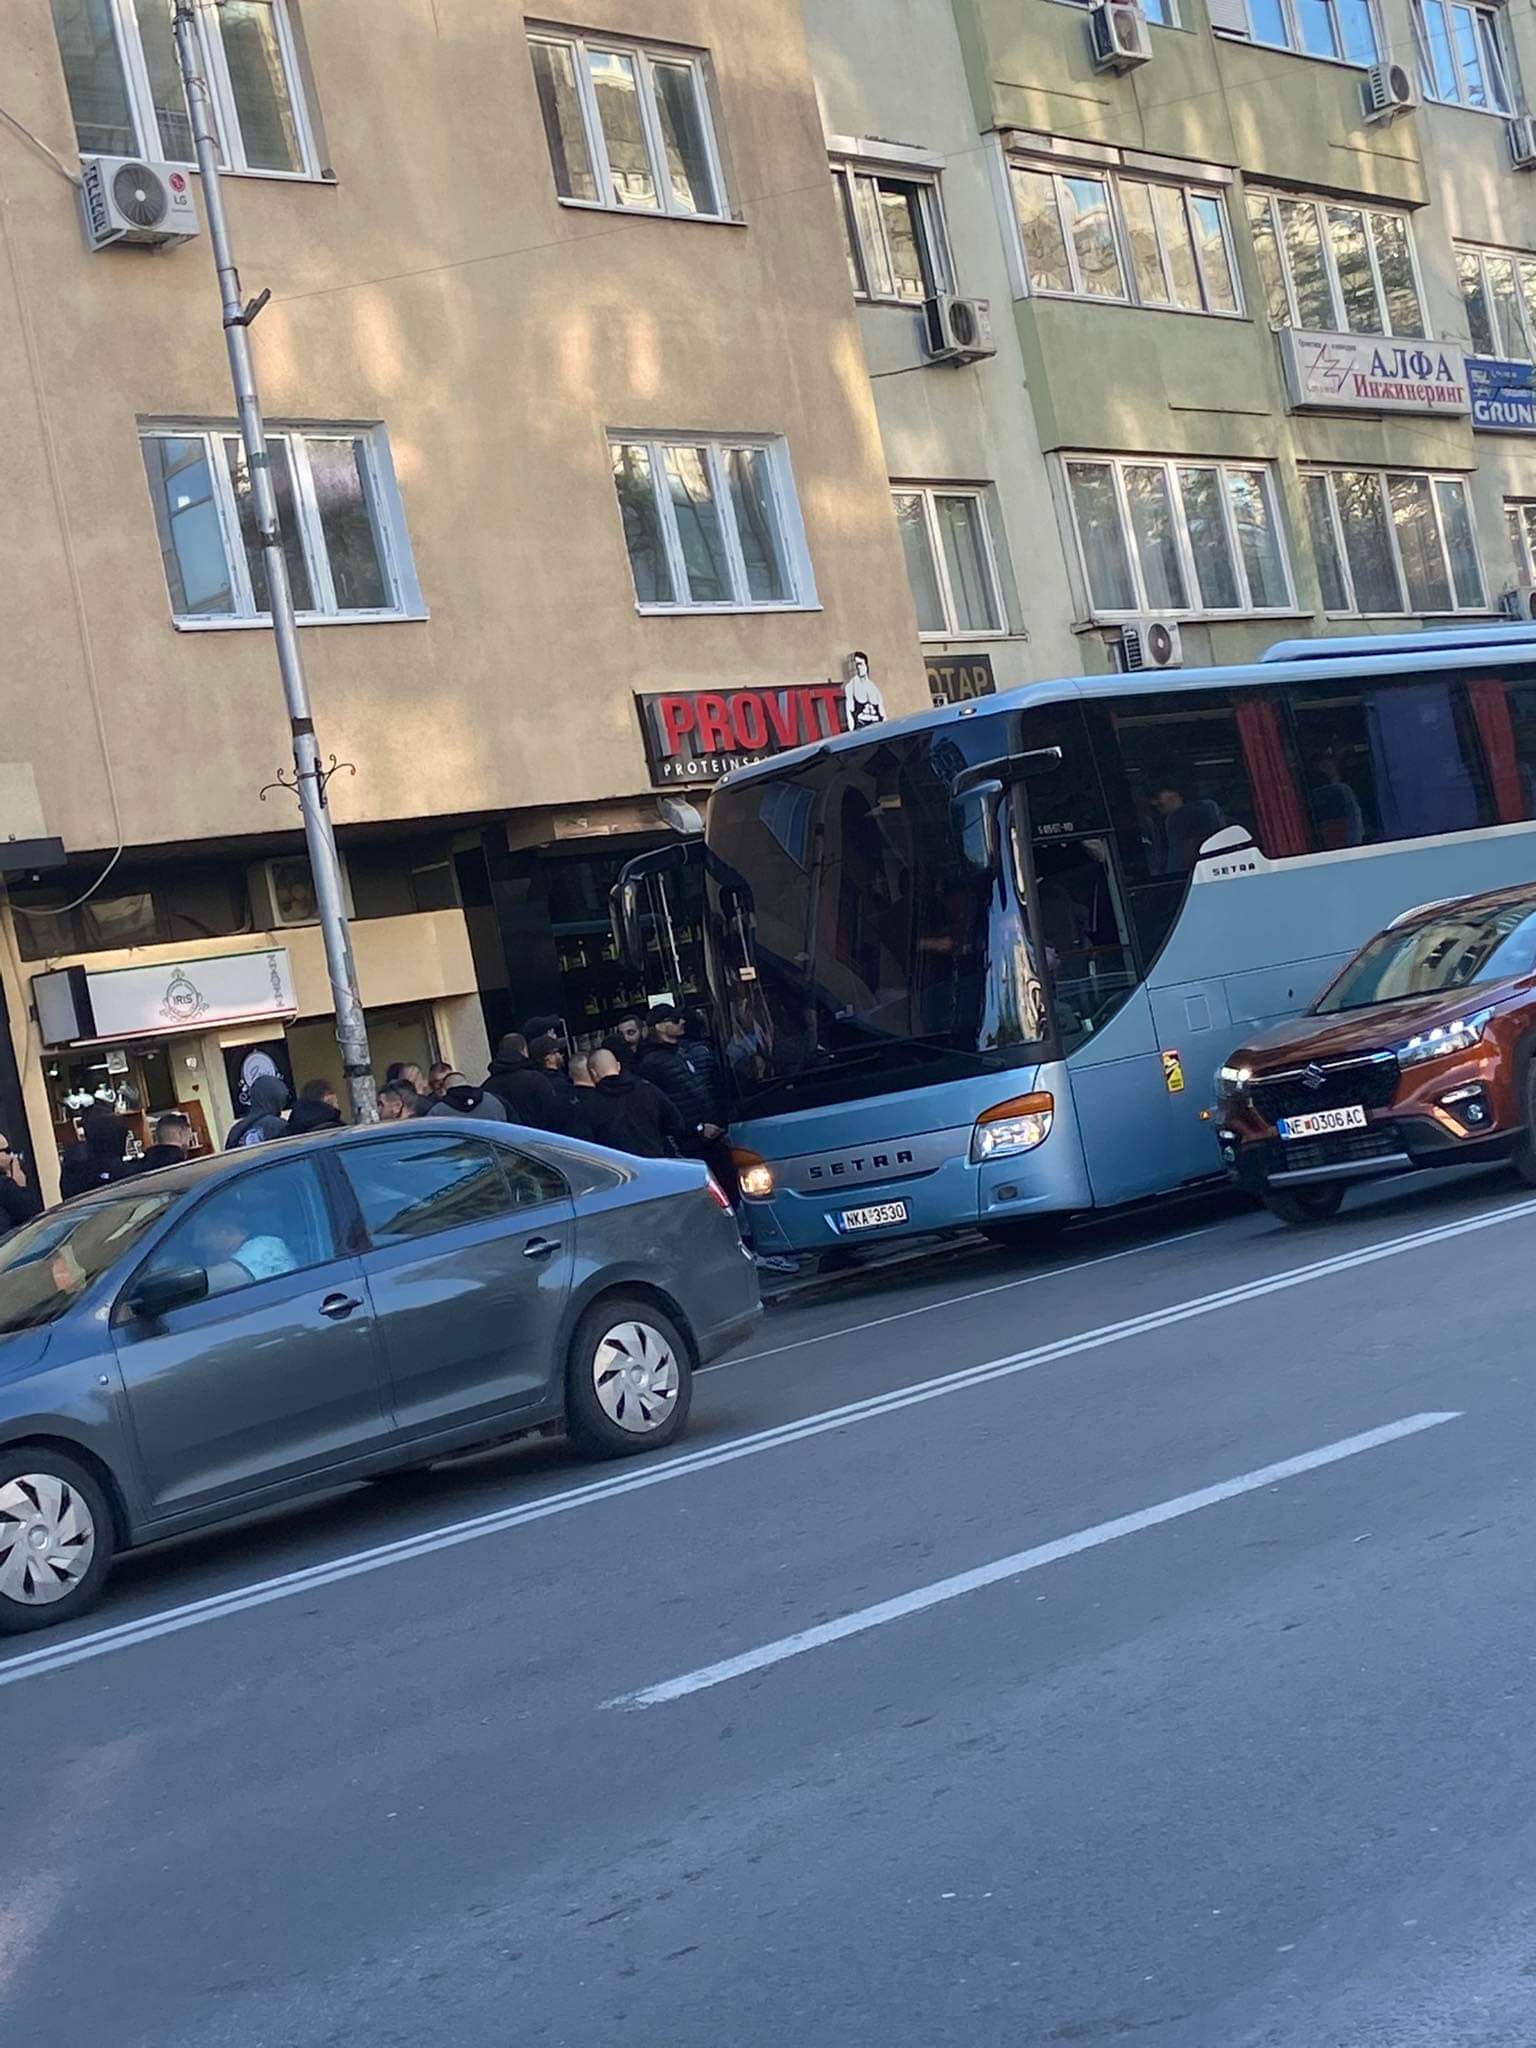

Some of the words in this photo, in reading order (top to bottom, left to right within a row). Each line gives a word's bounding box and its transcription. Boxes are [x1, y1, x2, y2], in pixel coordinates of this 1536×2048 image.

[173, 195, 188, 206] LG
[1370, 348, 1455, 382] АЛФА
[1353, 373, 1464, 407] Инжинеринг
[1474, 399, 1536, 424] GRUN
[658, 687, 844, 756] PROVIT
[1212, 862, 1255, 877] SETRA
[173, 992, 193, 1006] IRIS
[1285, 1119, 1305, 1136] NE
[809, 1151, 913, 1179] SETRA
